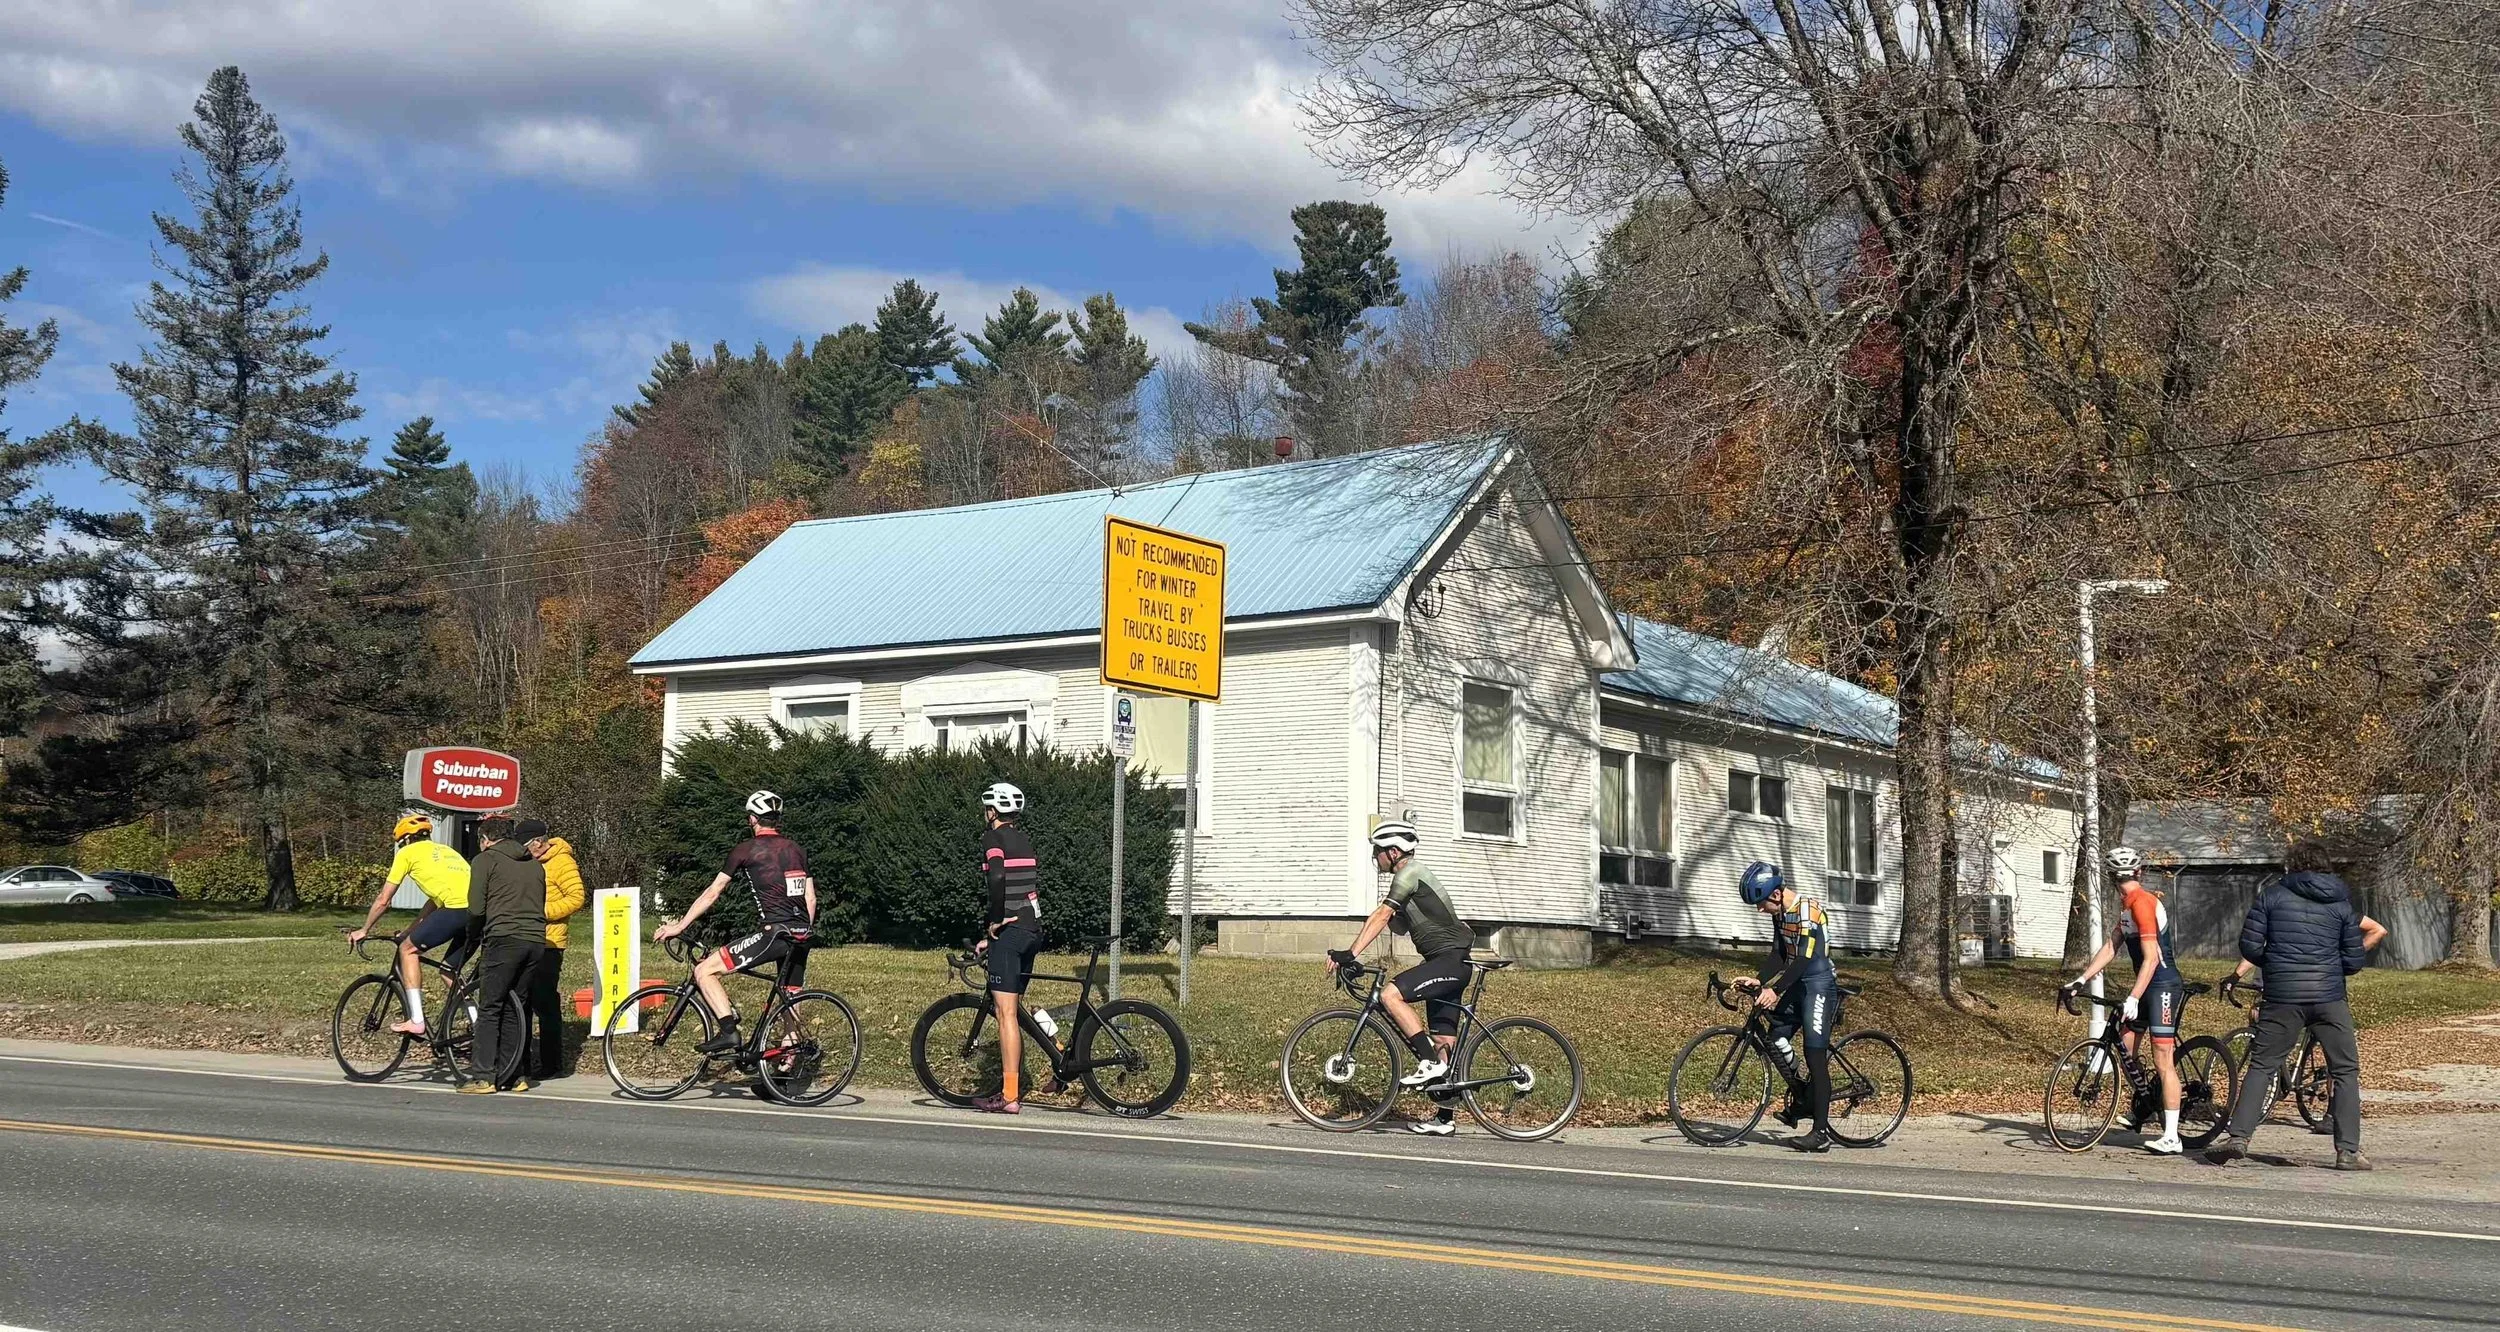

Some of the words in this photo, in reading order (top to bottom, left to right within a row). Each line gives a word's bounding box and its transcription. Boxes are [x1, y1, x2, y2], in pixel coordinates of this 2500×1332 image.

[1116, 535, 1136, 558] NOT
[1143, 542, 1218, 577] RECOMMENDED
[1136, 568, 1157, 591] FOR
[1161, 574, 1197, 599] WINTER
[1138, 597, 1175, 622] TRAVEL
[1180, 606, 1194, 625] BY
[1123, 618, 1162, 643] TRUCKS
[1167, 627, 1207, 652] BUSSES
[1130, 651, 1145, 672] OR
[1152, 656, 1198, 681] TRAILERS
[432, 759, 509, 780] Suburban
[436, 779, 503, 799] Propane
[1812, 993, 1826, 1035] MAVIC
[1115, 1105, 1128, 1114] DT
[1129, 1106, 1149, 1116] SWISS
